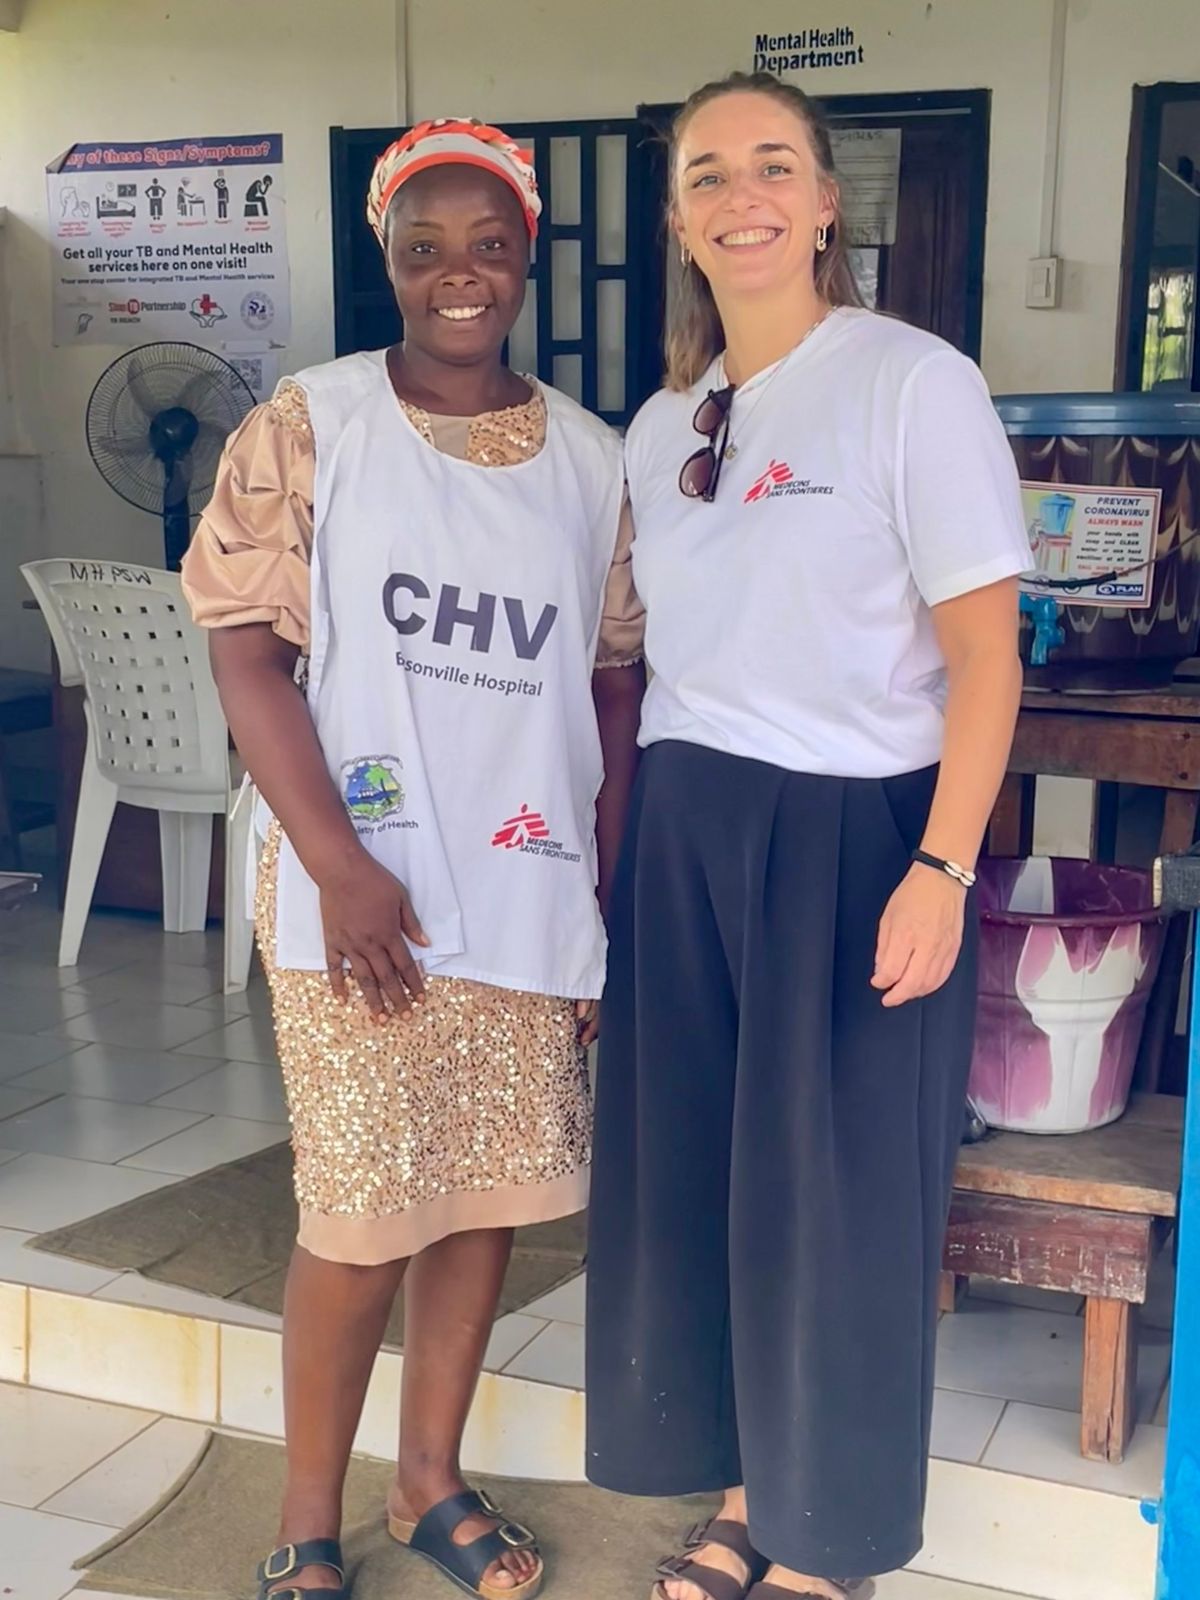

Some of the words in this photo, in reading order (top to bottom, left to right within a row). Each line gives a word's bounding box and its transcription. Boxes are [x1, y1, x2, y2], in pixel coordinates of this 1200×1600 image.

[756, 31, 806, 52] Mental
[809, 26, 854, 48] Health
[754, 45, 864, 76] Department
[86, 148, 102, 164] of
[103, 149, 142, 164] these
[143, 141, 270, 166] Signs/Symptoms?
[63, 248, 85, 259] Get
[87, 247, 102, 258] all
[105, 249, 133, 260] your
[136, 245, 153, 257] TB
[156, 245, 179, 257] and
[183, 243, 226, 256] Mental
[230, 242, 273, 254] Health
[89, 260, 138, 272] services
[141, 260, 169, 271] here
[172, 261, 188, 270] on
[190, 260, 213, 270] one
[216, 257, 247, 269] visit!
[141, 301, 186, 313] Partnership
[785, 486, 834, 496] FRONTIERES
[1097, 497, 1141, 506] PREVENT
[1084, 506, 1150, 517] CORONAVIRUS
[1088, 518, 1119, 526] ALWAYS
[1121, 519, 1143, 527] WASH
[69, 562, 104, 580] MH
[111, 566, 152, 585] PSW
[382, 572, 558, 660] CHV
[473, 672, 543, 696] Hospital
[377, 823, 386, 833] of
[388, 820, 419, 830] Health
[520, 844, 540, 855] SANS
[541, 848, 581, 862] FRONTIERES
